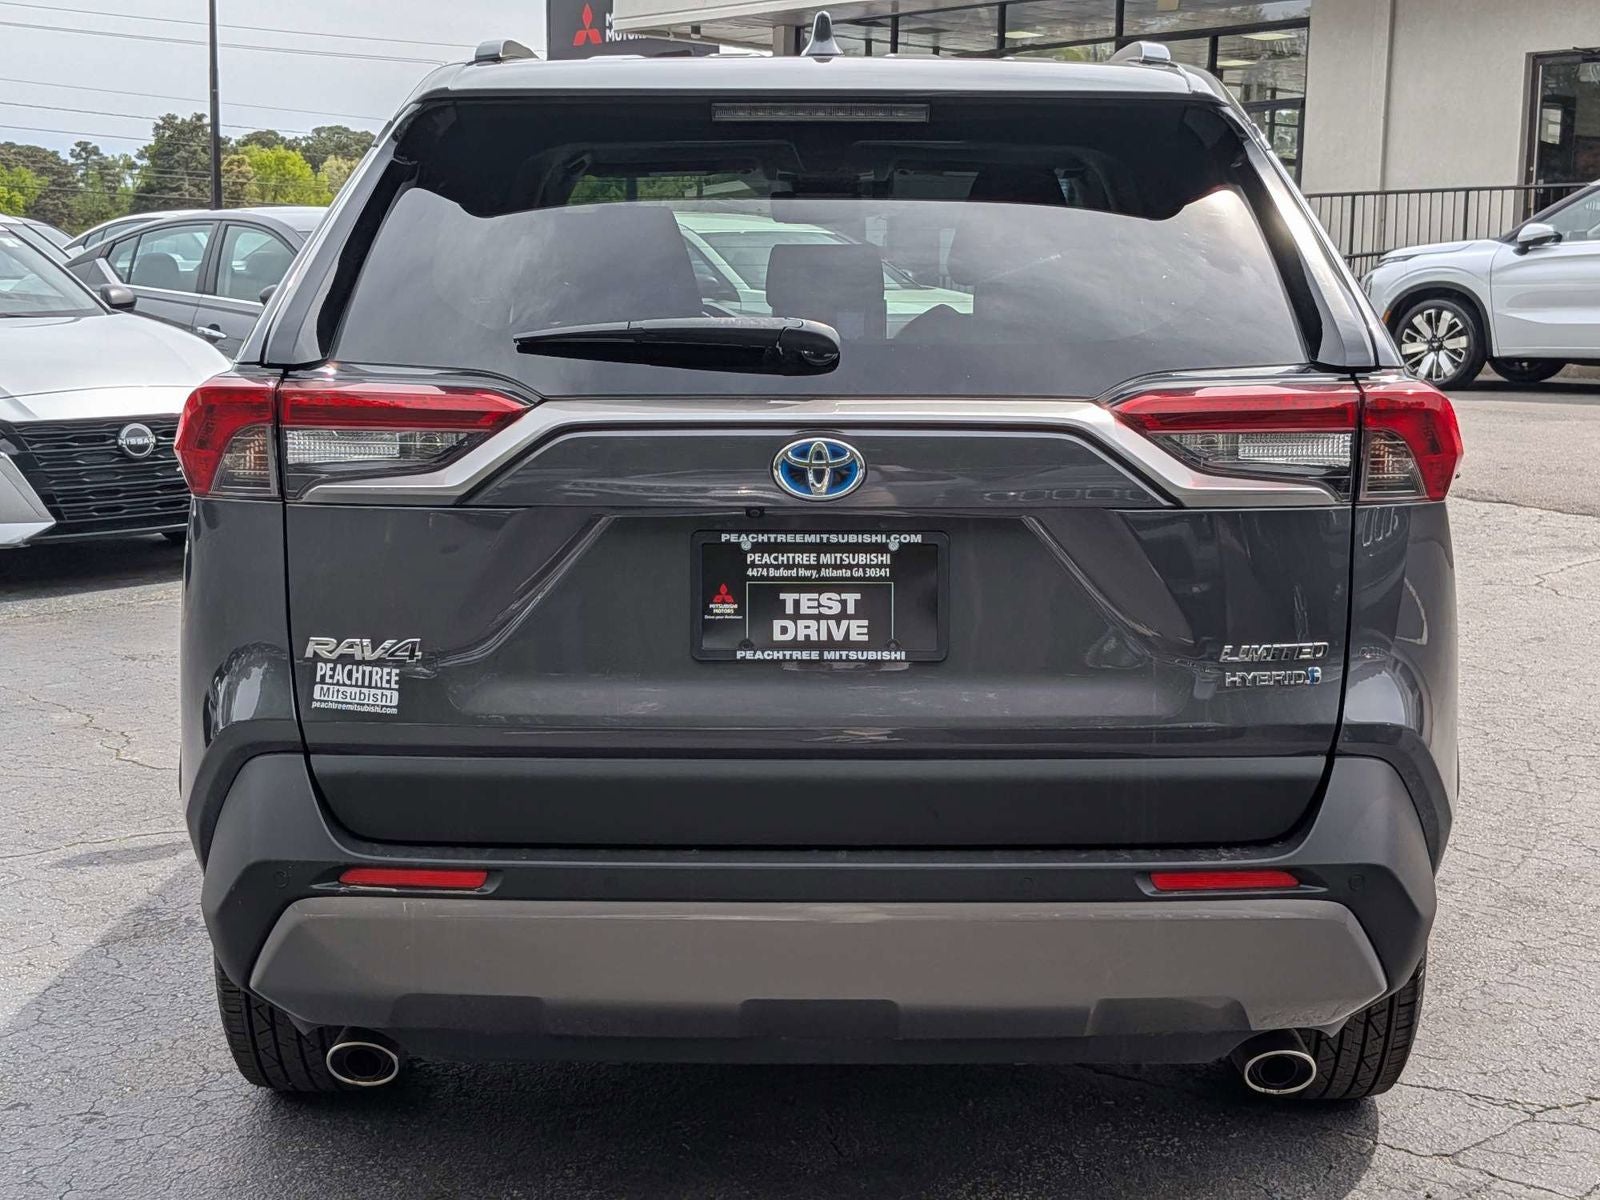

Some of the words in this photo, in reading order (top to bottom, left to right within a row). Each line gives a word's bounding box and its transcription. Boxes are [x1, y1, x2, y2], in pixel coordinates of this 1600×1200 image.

[118, 435, 156, 446] NISSAN
[721, 533, 922, 544] PEACHTREEMITSUBISHI.COM
[746, 553, 818, 565] PEACHTREE
[820, 553, 891, 565] MITSUBISHI
[746, 568, 767, 577] 4474
[769, 567, 797, 577] Buford
[798, 568, 819, 579] Hwy,
[820, 567, 851, 577] Atlanta
[852, 568, 864, 577] GA
[865, 568, 890, 577] 30341
[779, 592, 862, 615] TEST
[772, 619, 869, 641] DRIVE
[304, 636, 422, 663] RAV4
[736, 650, 820, 660] PEACHTREE
[823, 650, 906, 660] MITSUBISHI
[1219, 641, 1329, 662] LIMITED
[315, 662, 400, 689] PEACHTREE
[1225, 670, 1307, 687] HYBRID
[319, 686, 394, 704] Mitsubishi
[311, 700, 398, 714] peachtreemitsubishi.com
